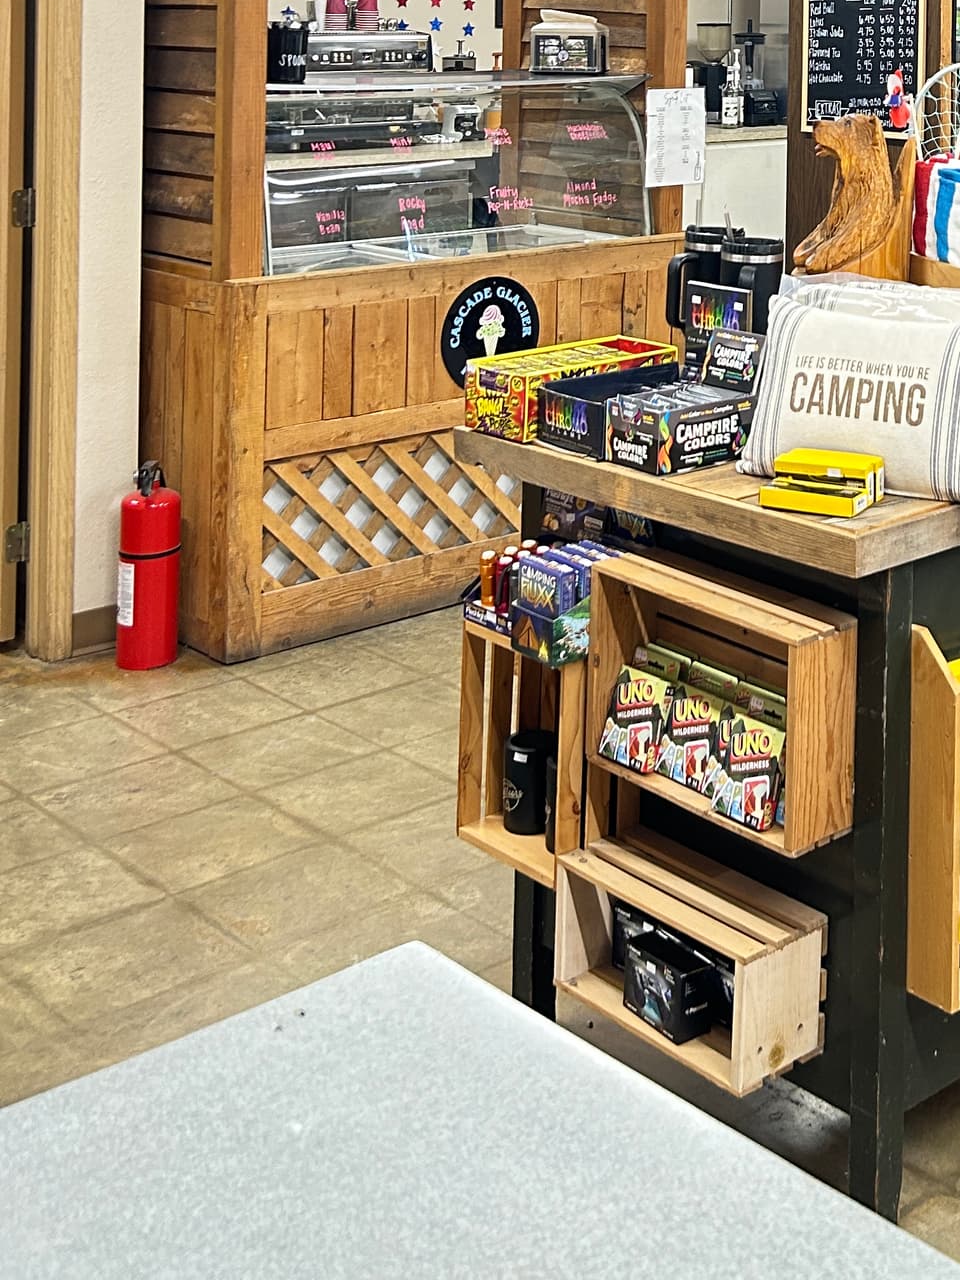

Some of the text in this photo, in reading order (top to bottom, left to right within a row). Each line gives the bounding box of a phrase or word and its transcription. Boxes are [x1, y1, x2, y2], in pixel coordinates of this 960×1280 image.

[809, 38, 819, 48] Tea
[566, 178, 597, 193] Almond
[399, 195, 427, 213] Rocky
[563, 191, 618, 208] Mocha Fudge
[450, 286, 532, 349] CASCADE GLACIER
[714, 343, 753, 365] CAMPFIRE
[717, 356, 745, 371] COLORS
[795, 355, 931, 381] LIFE IS BETTER WHEN YOU'RE
[789, 371, 928, 428] CAMPING
[675, 414, 740, 444] CAMPFIRE
[613, 436, 648, 460] CAMPFIRE
[684, 433, 732, 452] COLORS
[617, 450, 644, 466] COLORS
[521, 565, 556, 589] CAMPING
[618, 680, 655, 706] UNO
[617, 707, 653, 719] WILDERNESS
[674, 696, 712, 723] UNO
[673, 724, 710, 737] WILDERNESS
[733, 730, 773, 757] UNO
[731, 759, 770, 772] WILDERNESS
